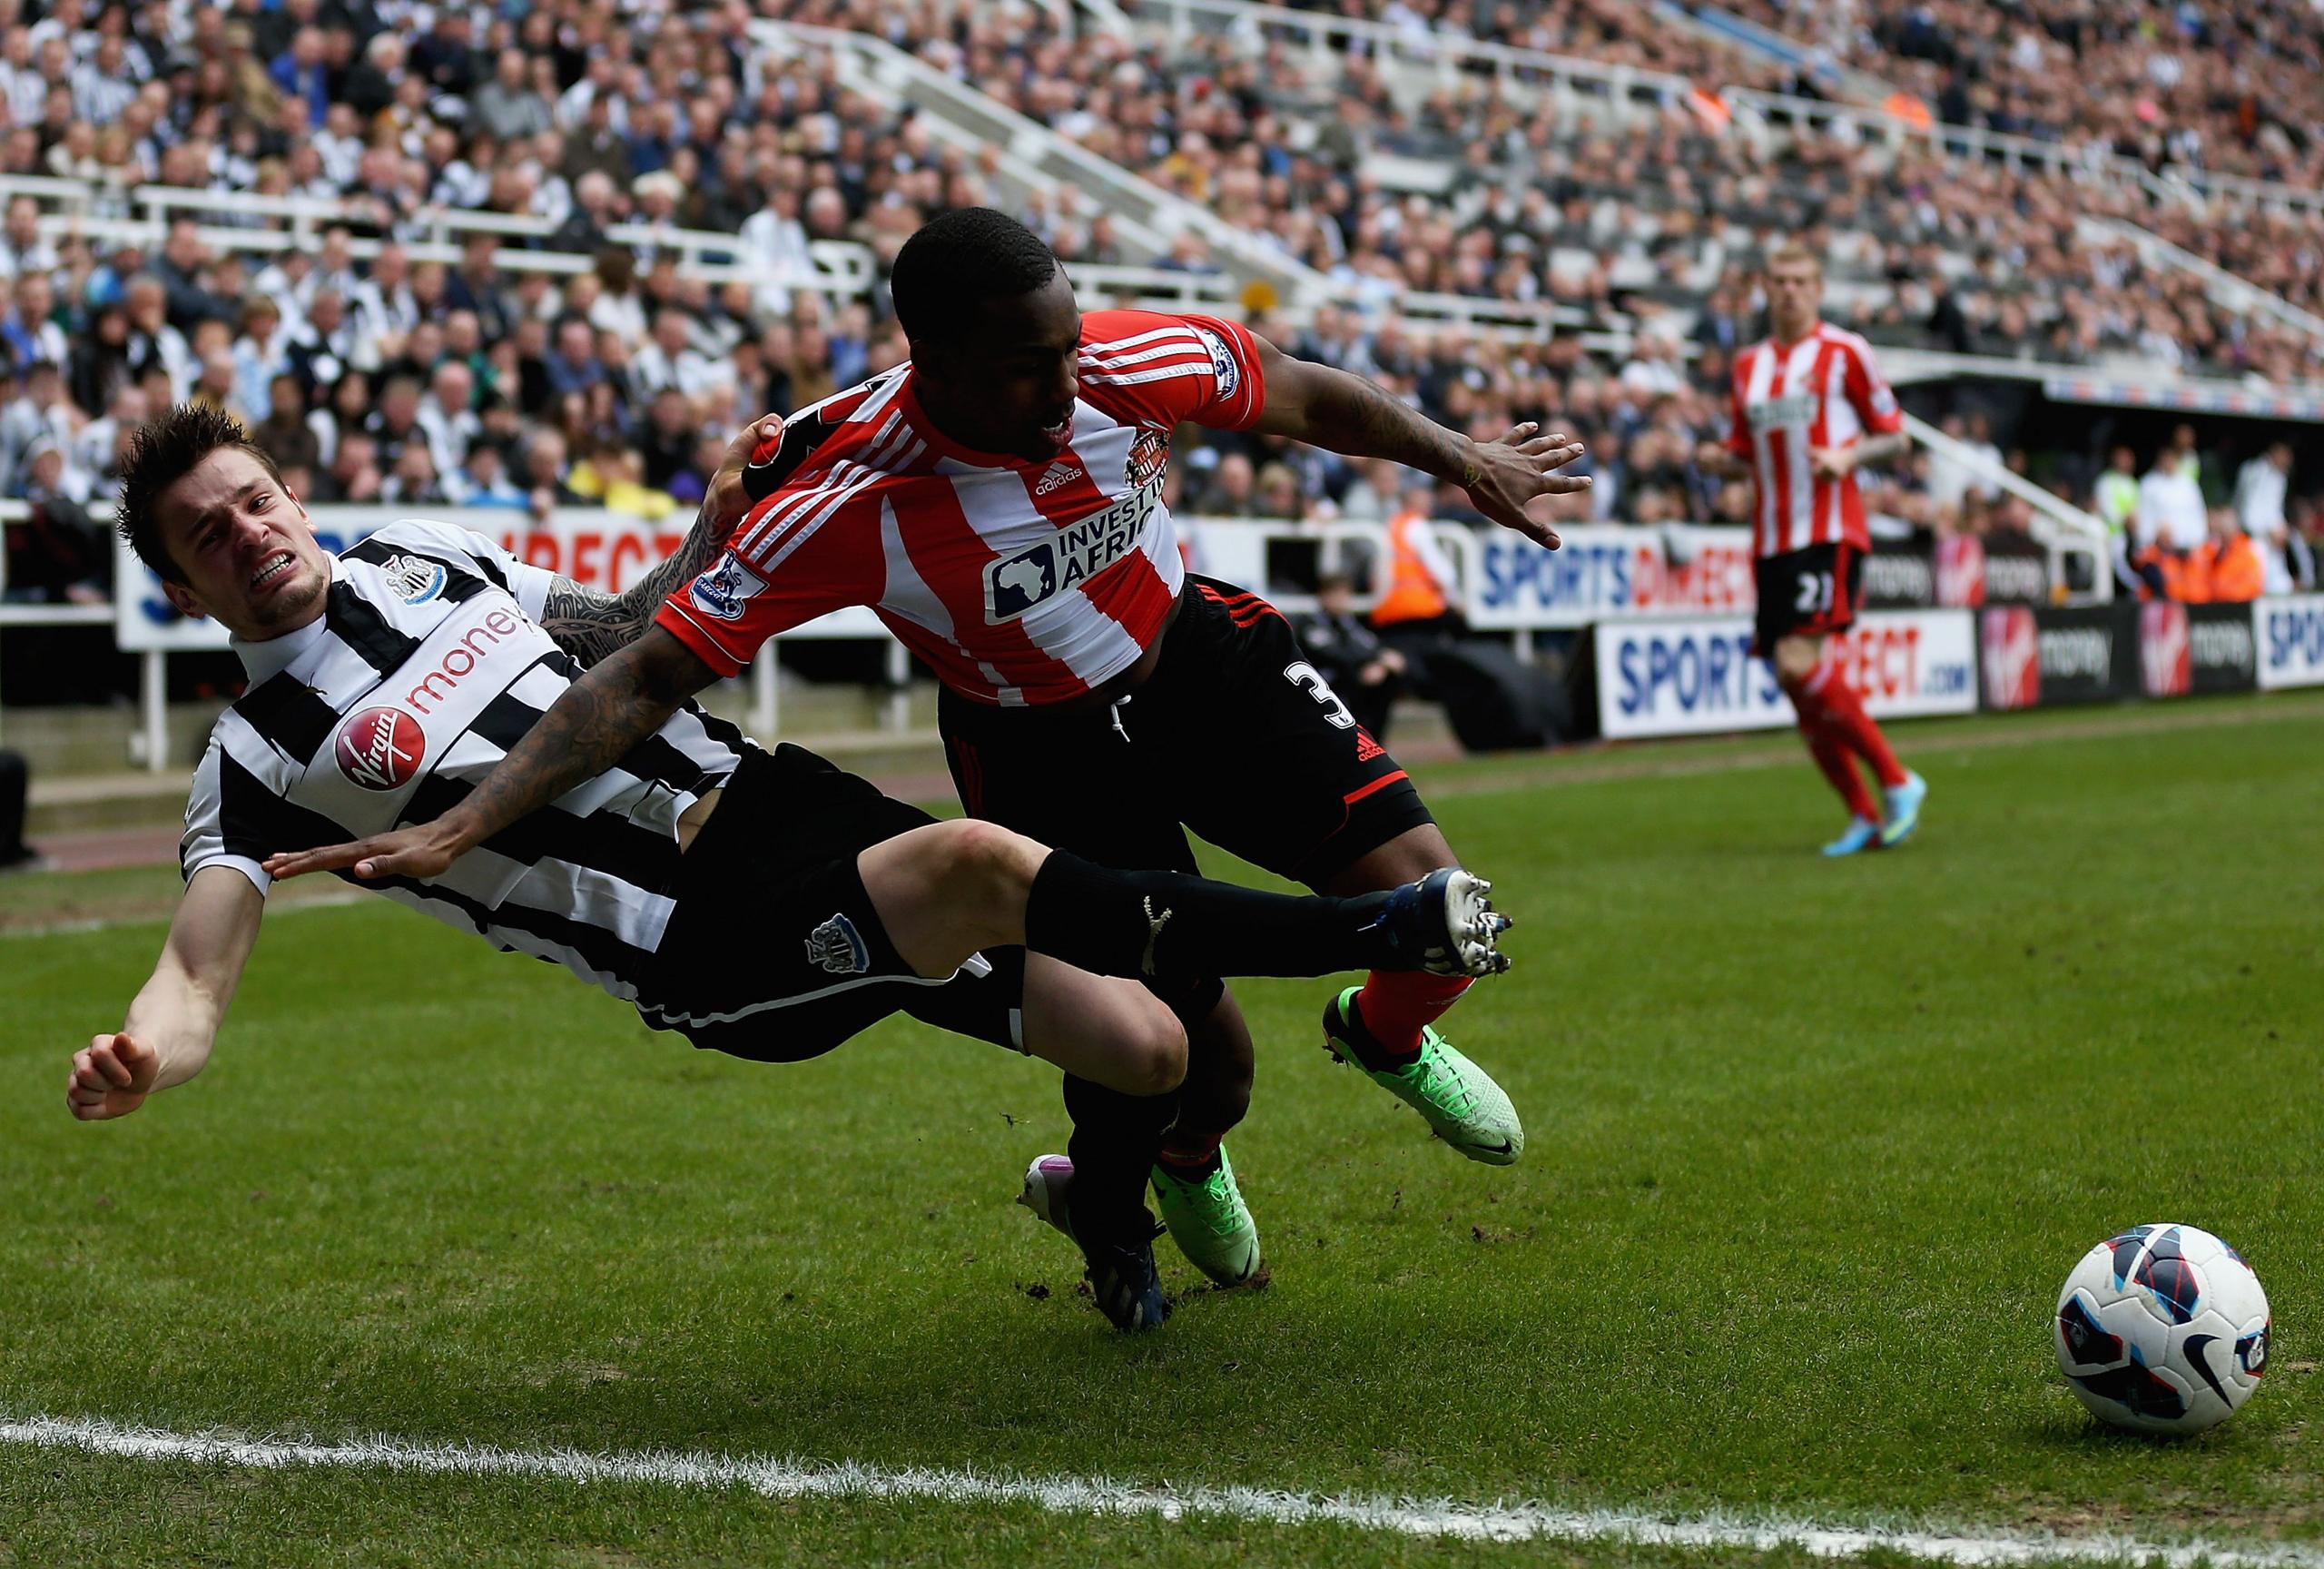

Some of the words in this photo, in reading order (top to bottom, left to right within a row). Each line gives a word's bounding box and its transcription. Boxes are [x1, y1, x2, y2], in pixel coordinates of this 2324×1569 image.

[1036, 466, 1083, 496] adidas
[1058, 487, 1147, 558] INVEST
[342, 711, 413, 786] Virgin
